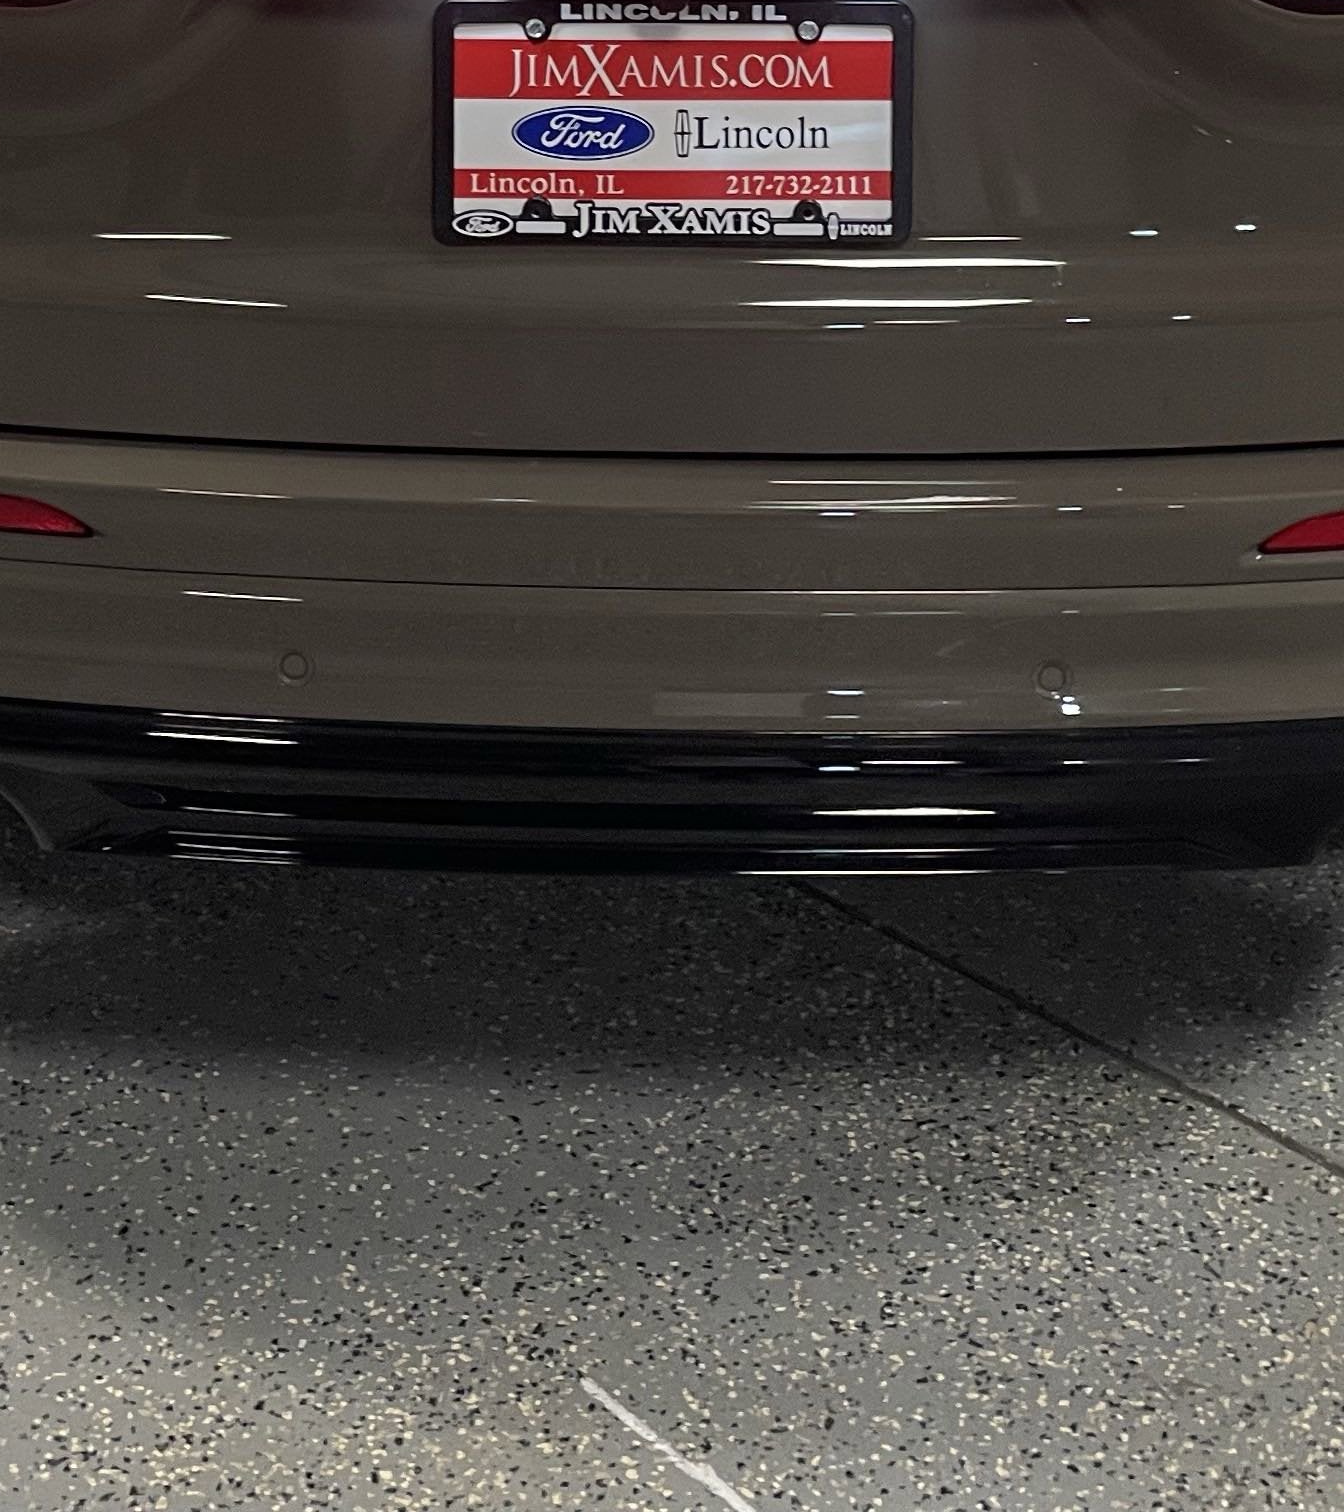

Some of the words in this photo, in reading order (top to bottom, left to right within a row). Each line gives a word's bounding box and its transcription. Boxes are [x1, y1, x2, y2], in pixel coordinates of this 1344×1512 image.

[752, 4, 787, 21] IL
[540, 113, 623, 150] Ford
[693, 116, 829, 150] Lincoln
[470, 173, 585, 196] Lincoln,
[595, 174, 624, 195] IL
[726, 175, 872, 196] 217-732-2111
[465, 216, 501, 234] Ford
[572, 203, 642, 238] JIM
[652, 205, 771, 235] XAMIS
[840, 223, 893, 236] LINCOLN
